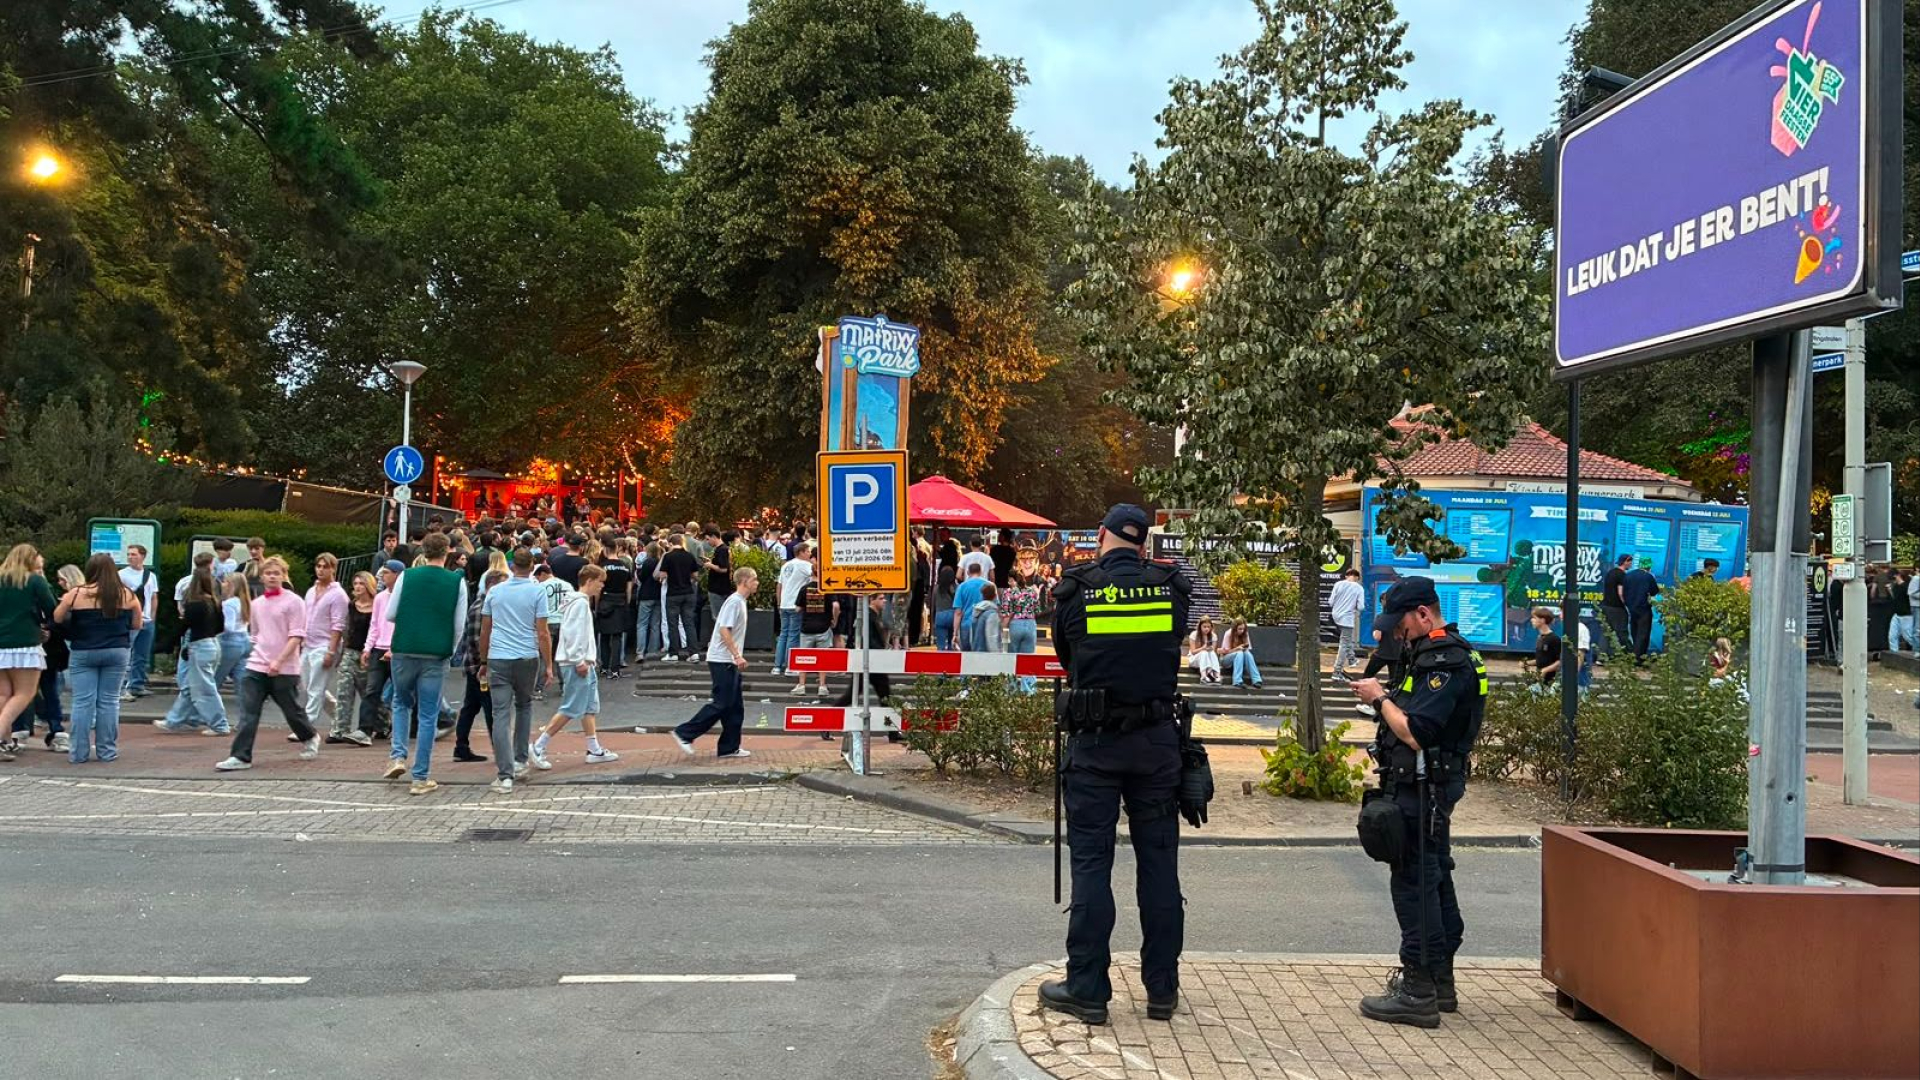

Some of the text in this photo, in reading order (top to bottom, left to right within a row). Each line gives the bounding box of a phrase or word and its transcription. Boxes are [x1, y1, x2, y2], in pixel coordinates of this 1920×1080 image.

[1780, 111, 1805, 145] FEESTEN
[1784, 100, 1813, 134] DAAGSE
[1566, 166, 1829, 297] LEUK DAT JE ER BENT!
[857, 345, 918, 371] Park
[845, 473, 880, 525] P
[1546, 509, 1595, 518] TIMBLE
[1094, 584, 1162, 602] POLITIE
[1526, 589, 1540, 599] 18
[1545, 589, 1559, 599] 24
